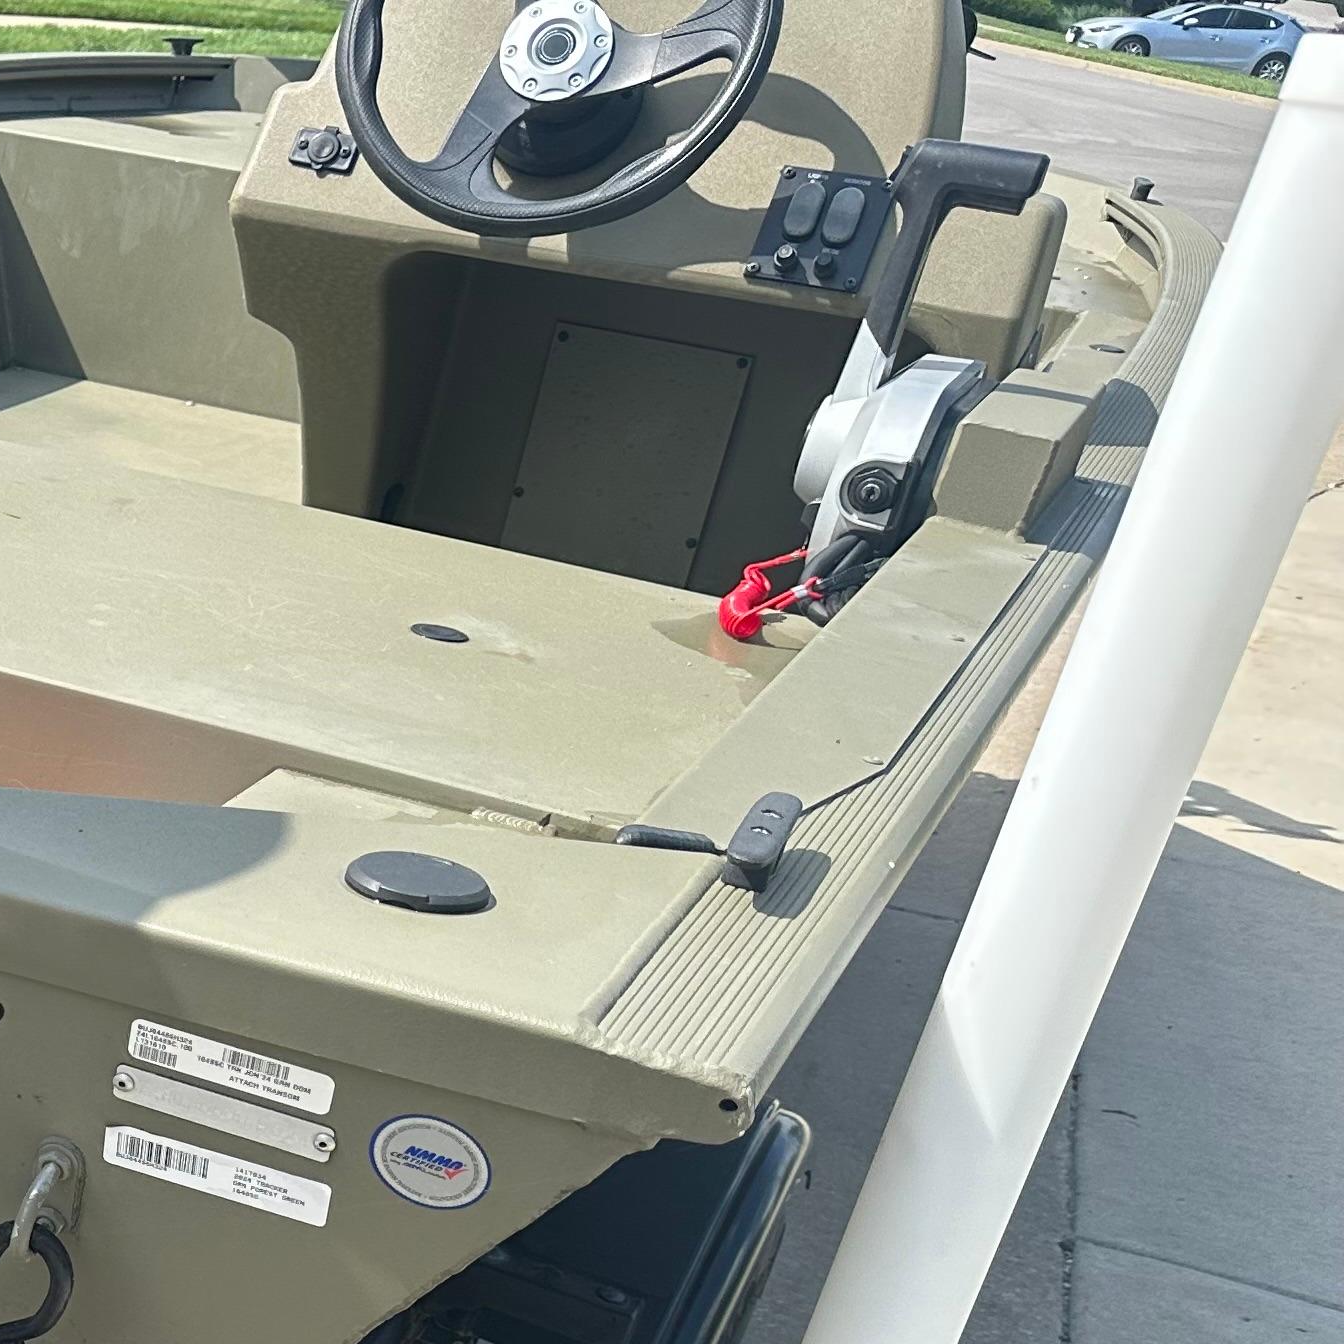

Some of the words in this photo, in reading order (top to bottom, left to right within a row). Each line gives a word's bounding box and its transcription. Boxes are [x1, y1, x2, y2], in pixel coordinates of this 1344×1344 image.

[228, 1075, 260, 1090] ATTACH
[261, 1084, 301, 1102] TRANSOM
[389, 1151, 444, 1172] CERTIFIED
[250, 1185, 278, 1199] FOREST
[281, 1194, 306, 1207] GREEN
[256, 1180, 289, 1195] TRACKER
